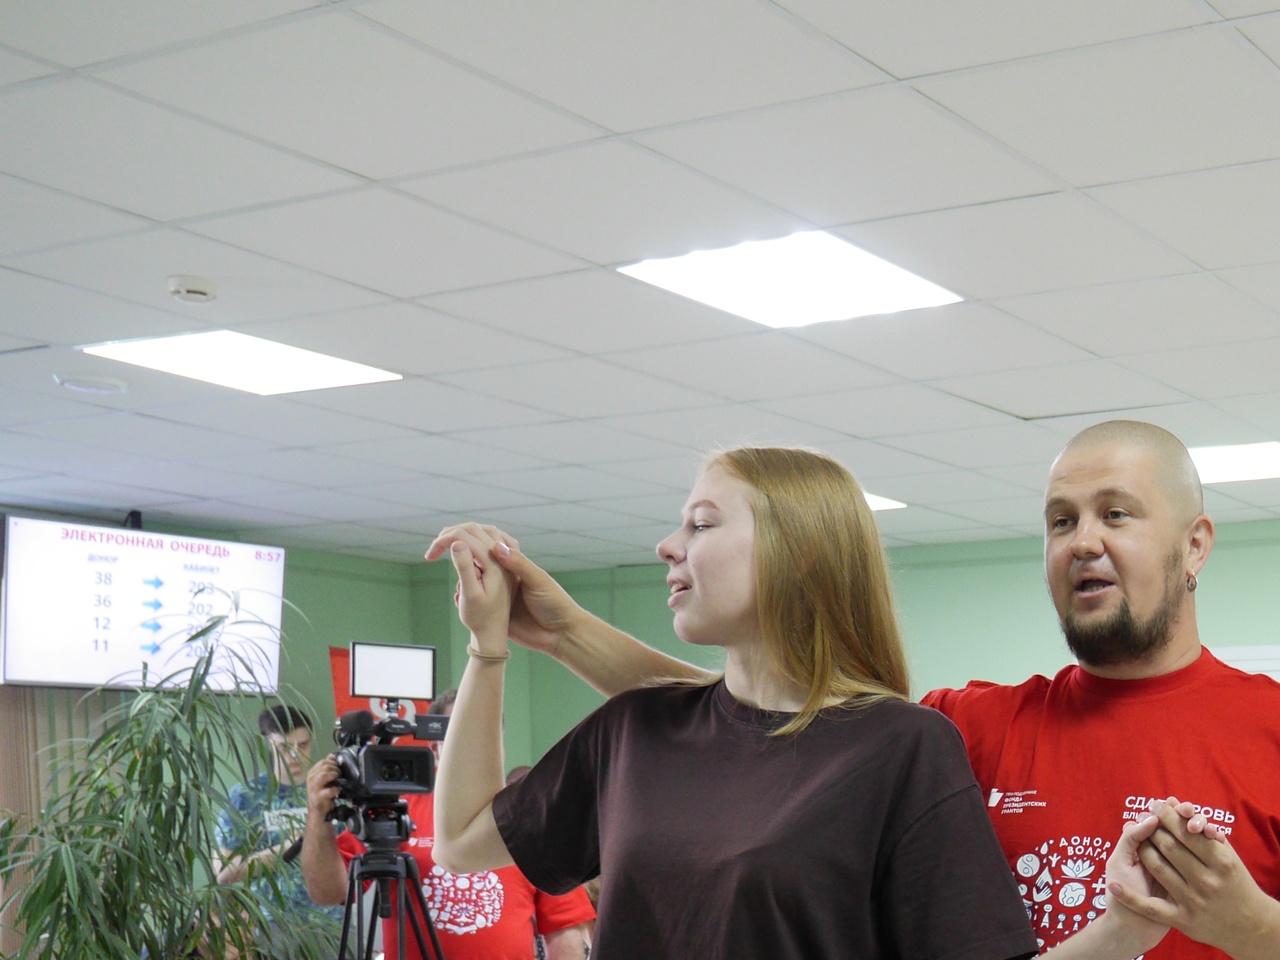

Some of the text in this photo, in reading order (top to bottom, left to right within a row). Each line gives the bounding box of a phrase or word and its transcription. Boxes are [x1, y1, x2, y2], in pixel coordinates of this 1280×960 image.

[61, 527, 230, 558] ЭЛЕКТРОННАЯ ОЧЕРЕДЬ
[255, 549, 281, 562] 8:57
[93, 572, 112, 585] 38
[93, 594, 111, 608] 36
[188, 602, 213, 616] 202
[93, 616, 110, 631] 12
[92, 639, 109, 653] 11
[1193, 804, 1236, 824] РОВЬ
[1059, 836, 1111, 850] ДОНОР
[1067, 845, 1107, 860] ВОЛГА
